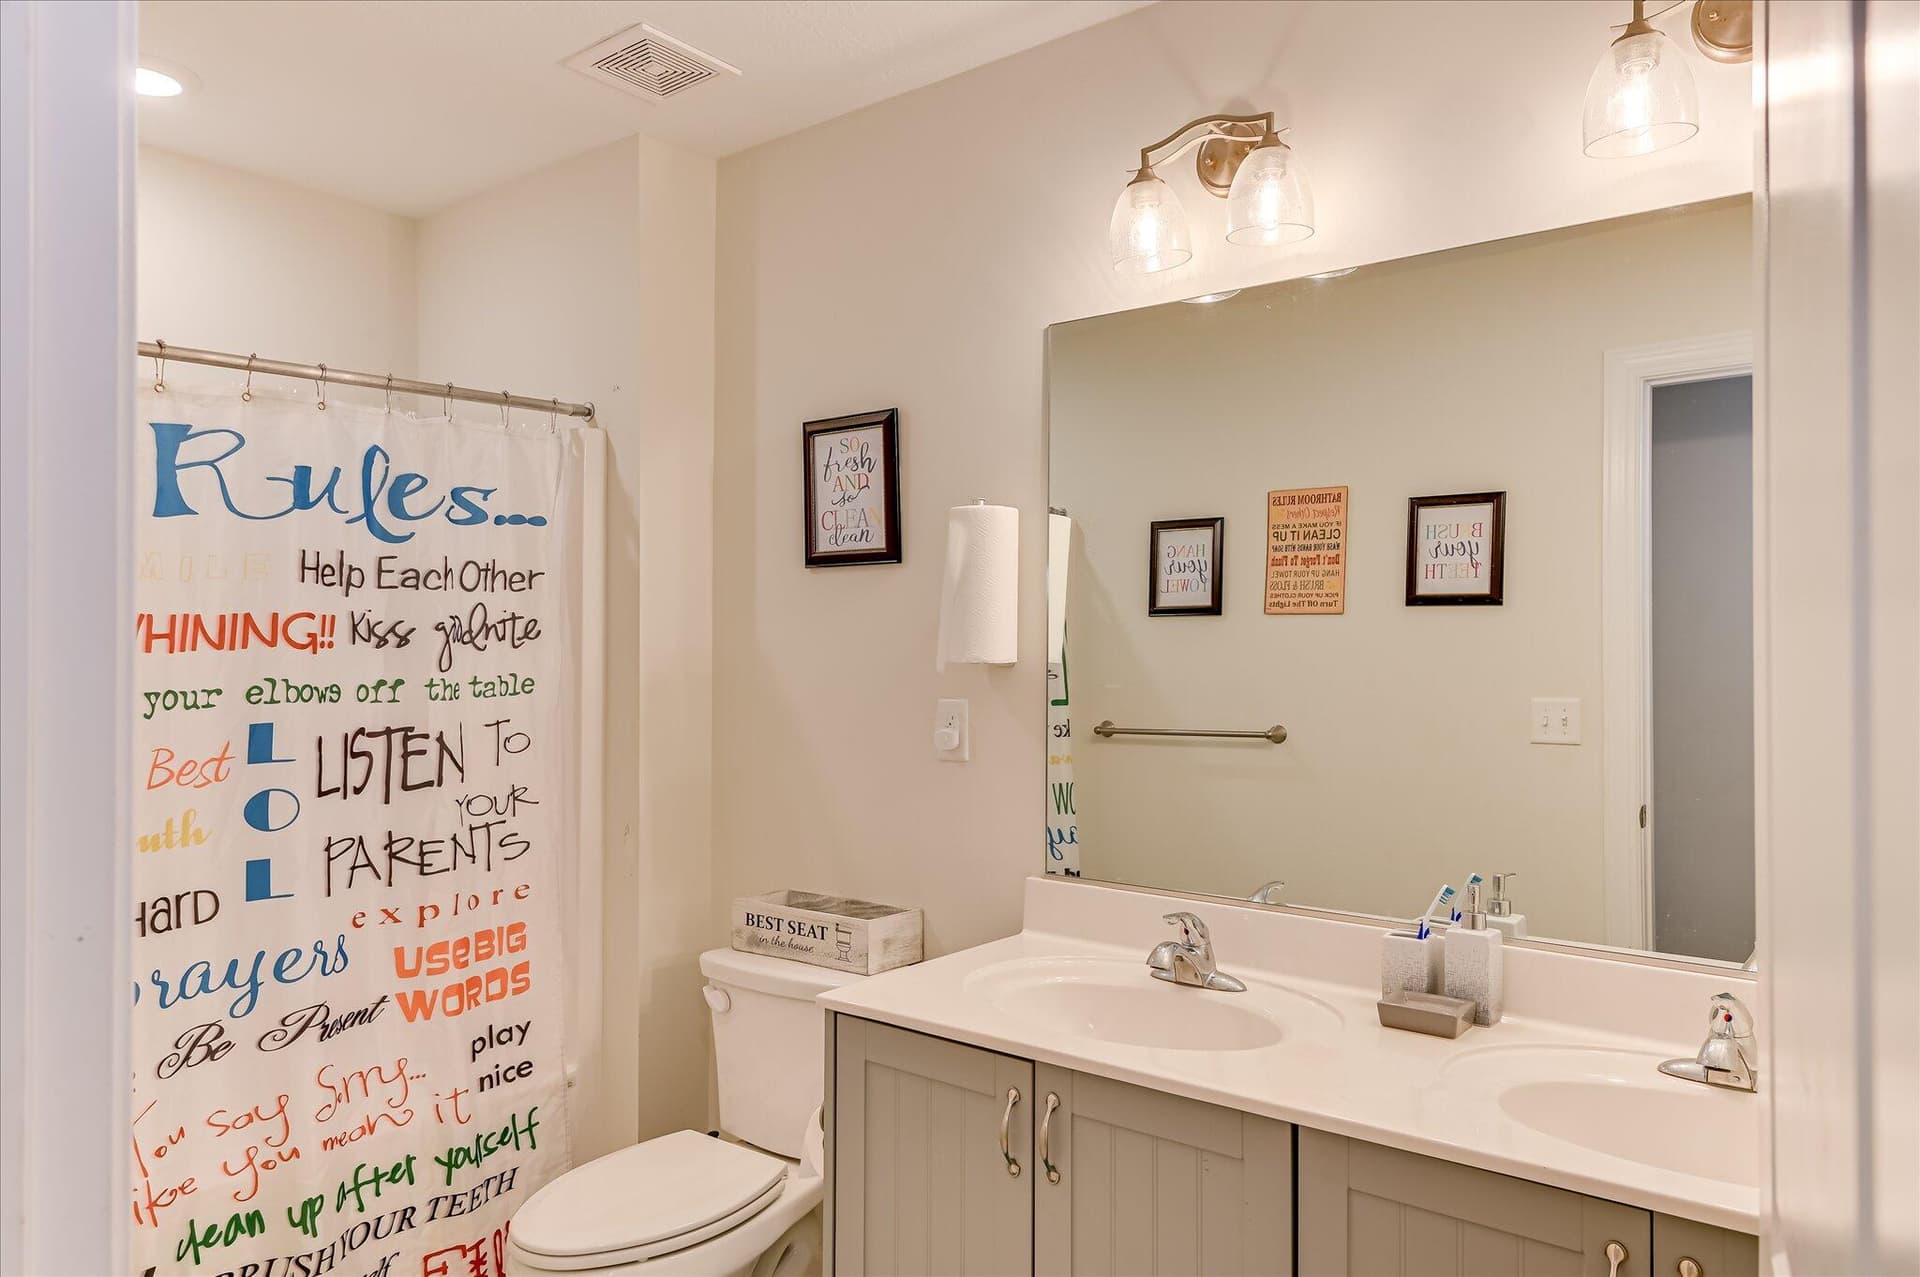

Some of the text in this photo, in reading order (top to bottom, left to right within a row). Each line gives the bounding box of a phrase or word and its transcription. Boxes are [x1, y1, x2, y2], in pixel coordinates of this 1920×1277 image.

[824, 441, 878, 482] fresh
[840, 437, 860, 454] SO
[833, 472, 870, 493] AND
[829, 523, 875, 547] clean
[300, 549, 365, 597] Help
[376, 555, 453, 592] Each
[459, 558, 545, 592] Other
[350, 610, 416, 650] Kiss
[143, 672, 536, 720] your elbows off the table
[147, 740, 236, 790] Best
[317, 722, 464, 804] LISTEN
[324, 821, 531, 897] PARENTS
[352, 882, 531, 928] explore
[744, 912, 828, 941] BEST SEAT
[771, 935, 785, 948] the
[787, 938, 815, 954] house
[134, 933, 350, 1018] rayers
[395, 960, 531, 1023] WORDS
[156, 1020, 237, 1080] Be
[471, 1019, 532, 1062] play
[479, 1057, 534, 1093] nice
[206, 1094, 289, 1147] say
[433, 1087, 470, 1124] it
[287, 1193, 324, 1238] up
[336, 1154, 417, 1213] after
[340, 1206, 417, 1261] YOUR
[424, 1166, 520, 1224] TEETH
